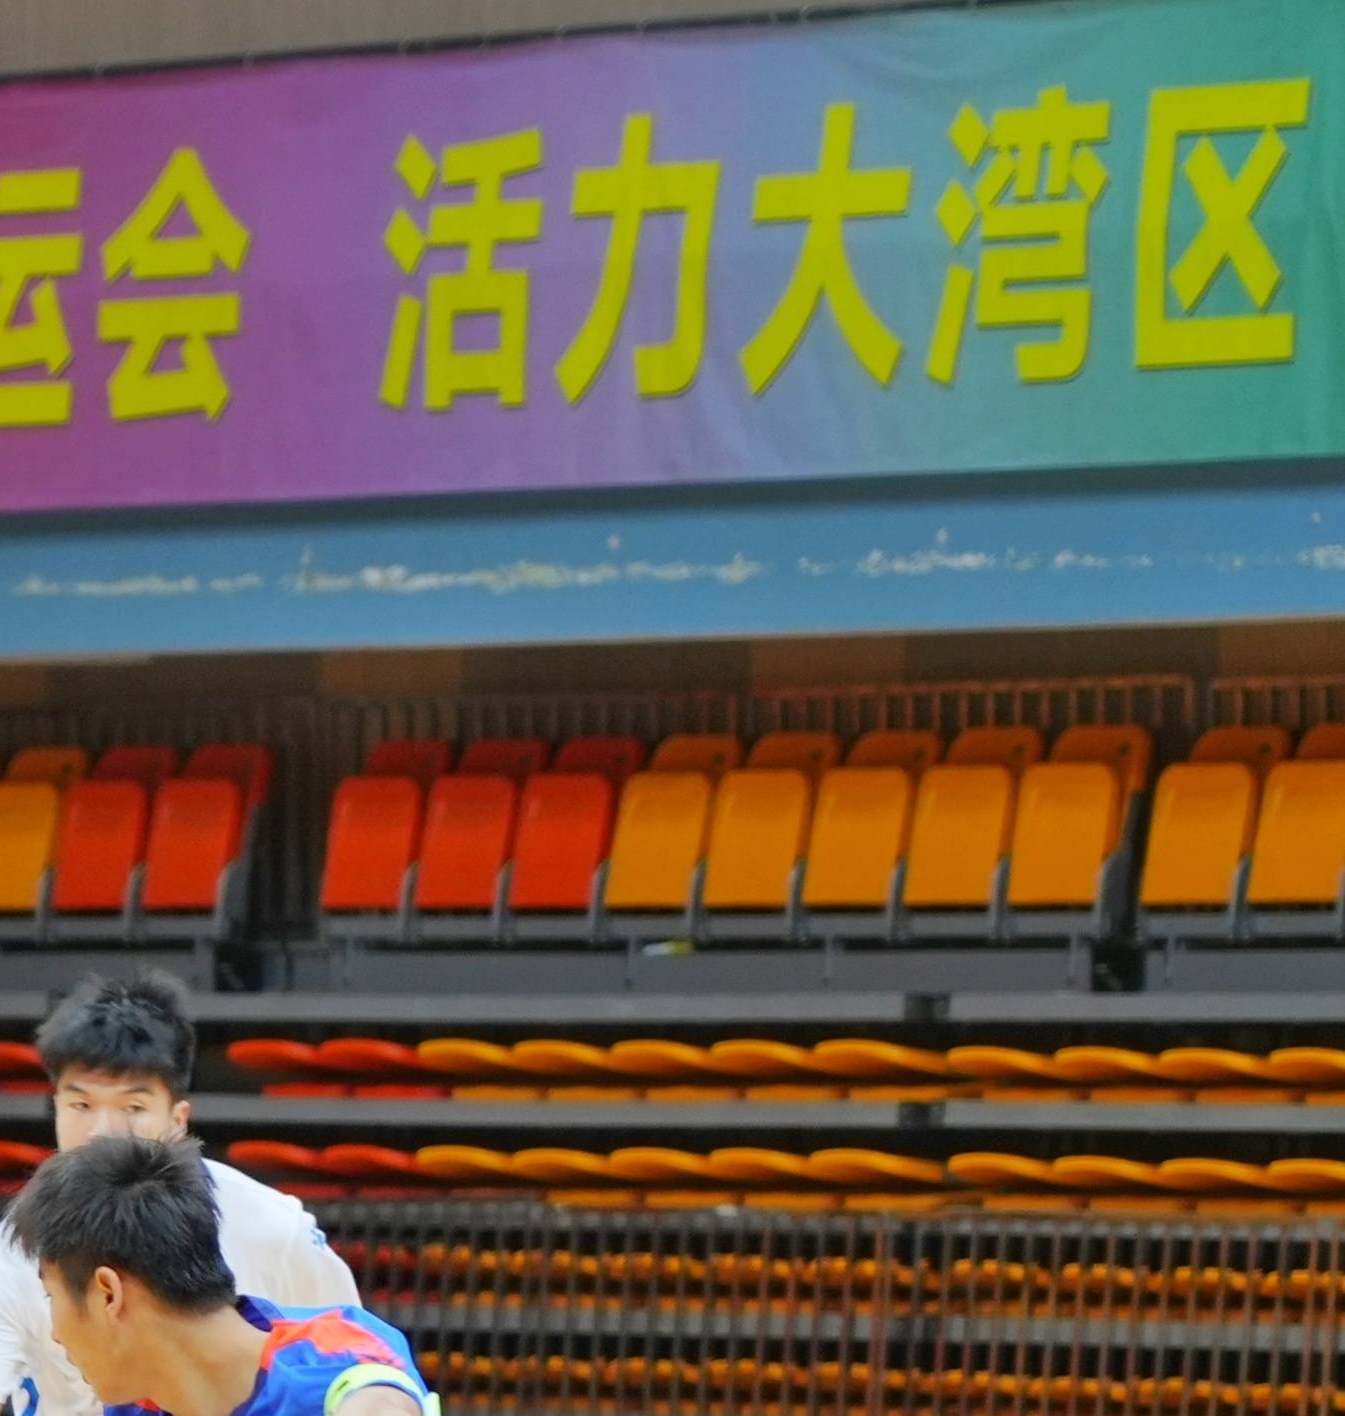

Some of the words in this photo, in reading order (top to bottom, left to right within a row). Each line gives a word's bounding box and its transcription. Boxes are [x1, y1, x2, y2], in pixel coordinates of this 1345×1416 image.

[379, 77, 1311, 411] 活力大湾区
